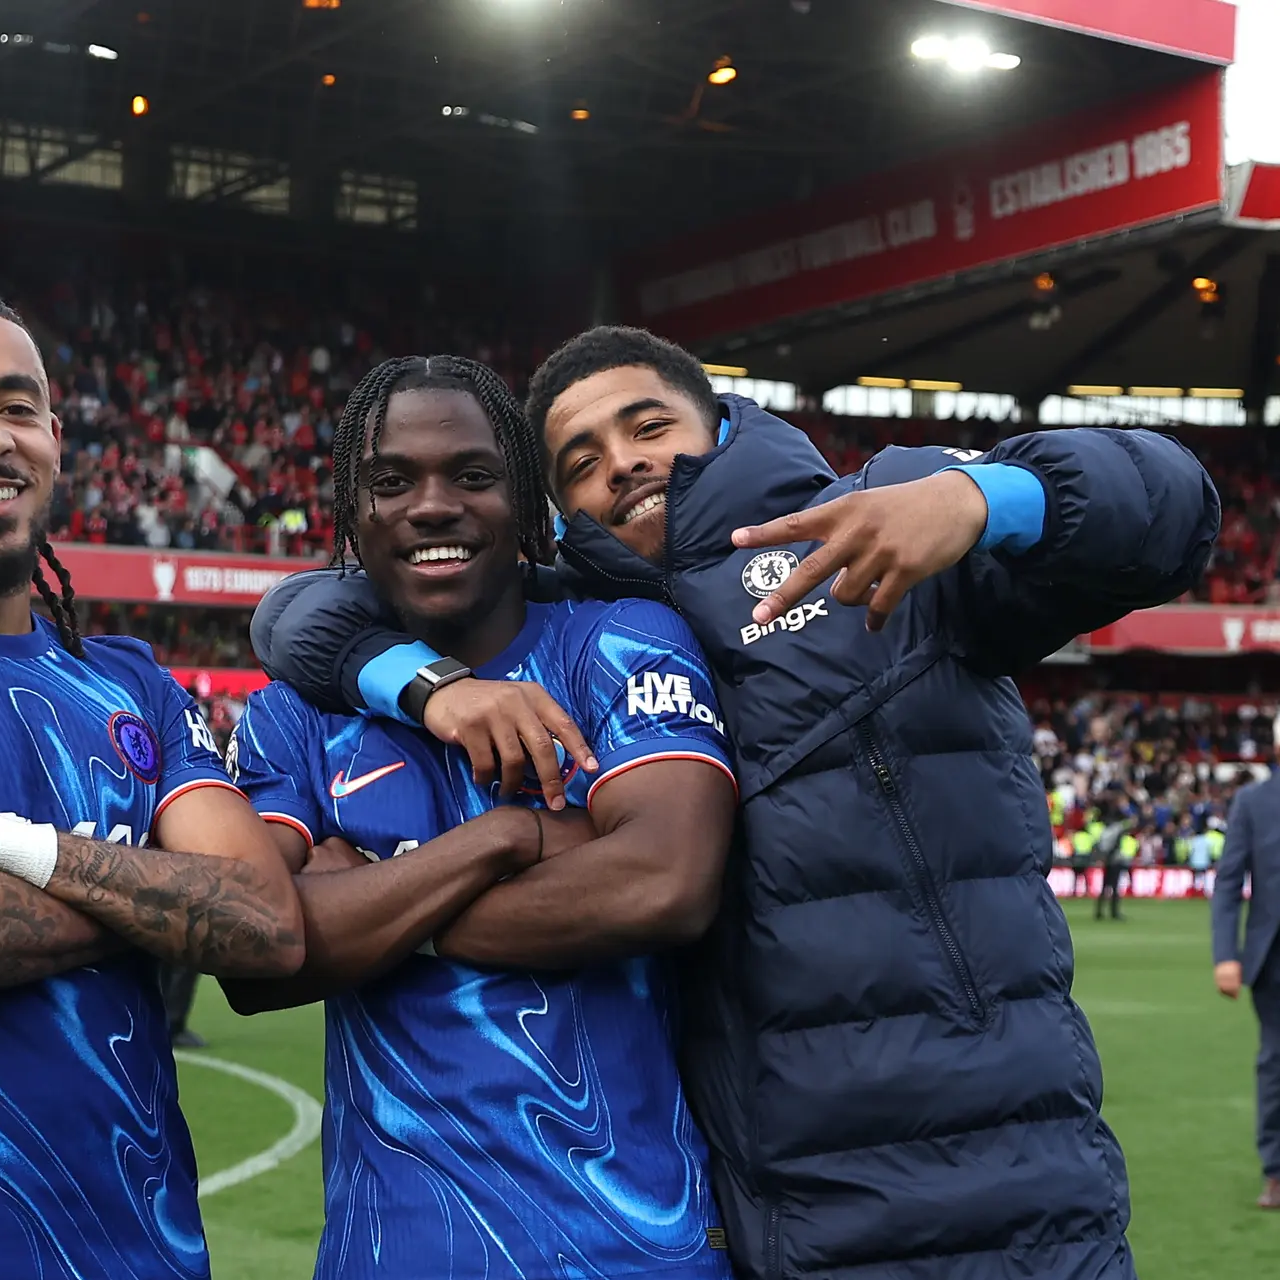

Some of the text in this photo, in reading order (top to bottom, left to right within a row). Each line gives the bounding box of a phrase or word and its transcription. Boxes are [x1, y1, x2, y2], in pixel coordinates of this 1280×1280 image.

[989, 140, 1130, 219] ESTABLISHED
[627, 671, 692, 696] LIVE
[627, 692, 725, 737] NATION
